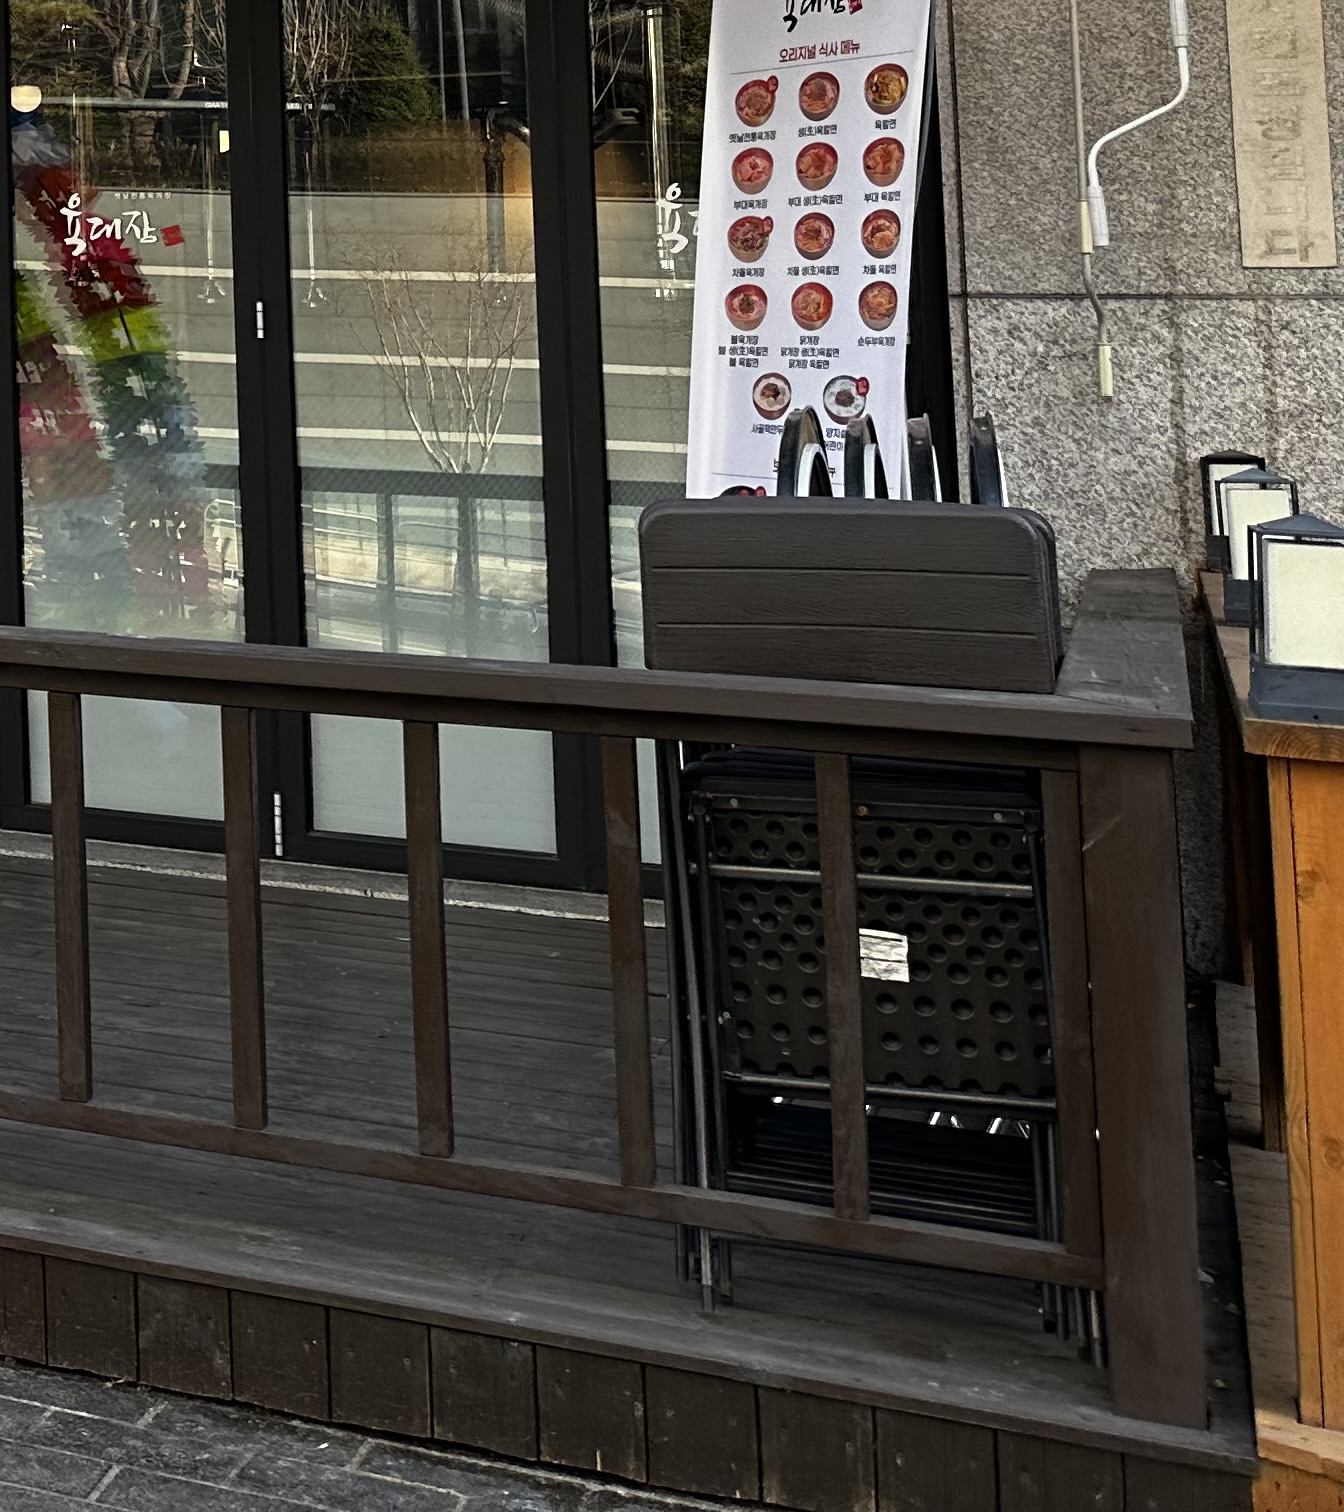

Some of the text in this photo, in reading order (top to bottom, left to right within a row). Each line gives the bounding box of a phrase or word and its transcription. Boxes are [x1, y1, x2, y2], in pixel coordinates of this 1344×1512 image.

[779, 39, 861, 63] 오리지널 식사 메뉴
[60, 192, 158, 257] 육대장
